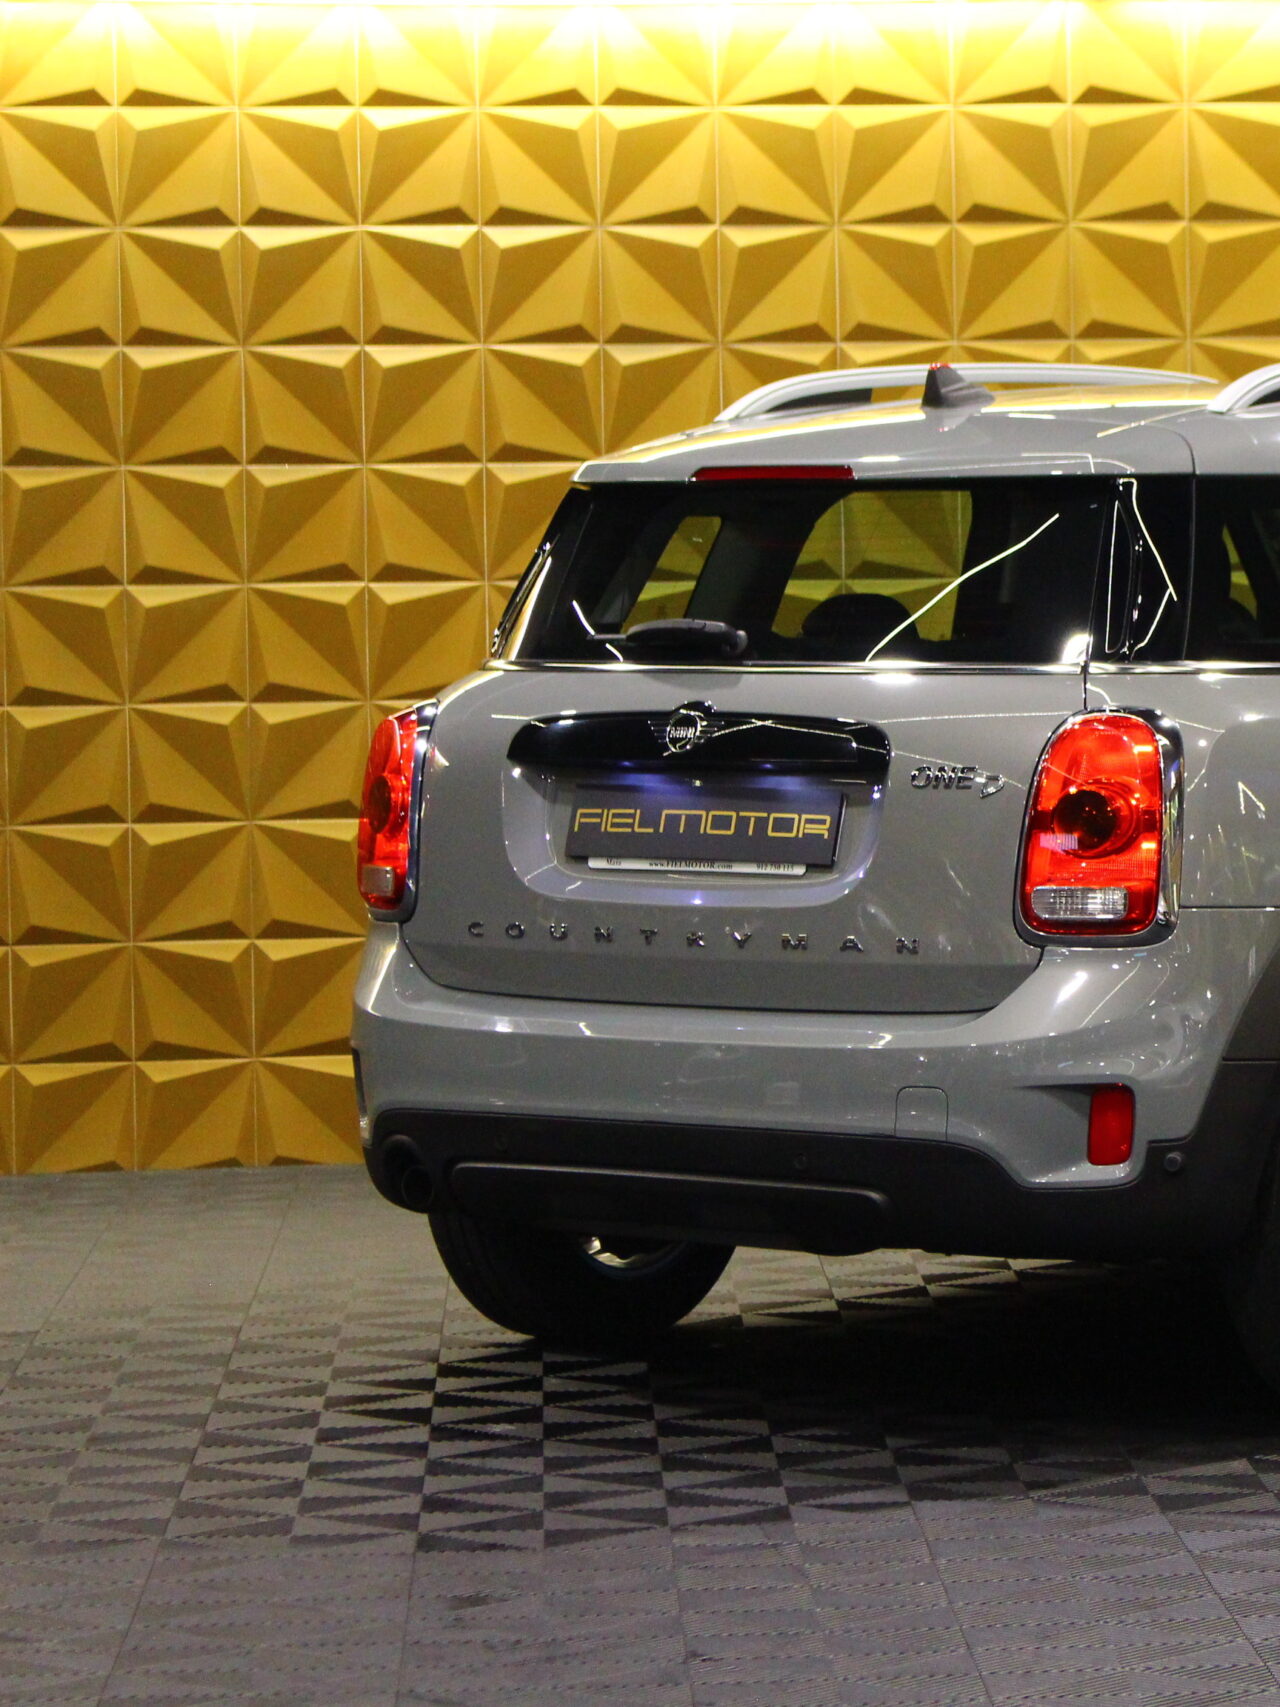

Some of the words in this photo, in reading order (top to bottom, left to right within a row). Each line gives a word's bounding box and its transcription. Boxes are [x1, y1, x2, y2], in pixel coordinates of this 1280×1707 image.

[910, 765, 978, 790] ONE
[573, 807, 831, 840] FIELMOTOR
[467, 920, 921, 956] COUNTRYMAN
